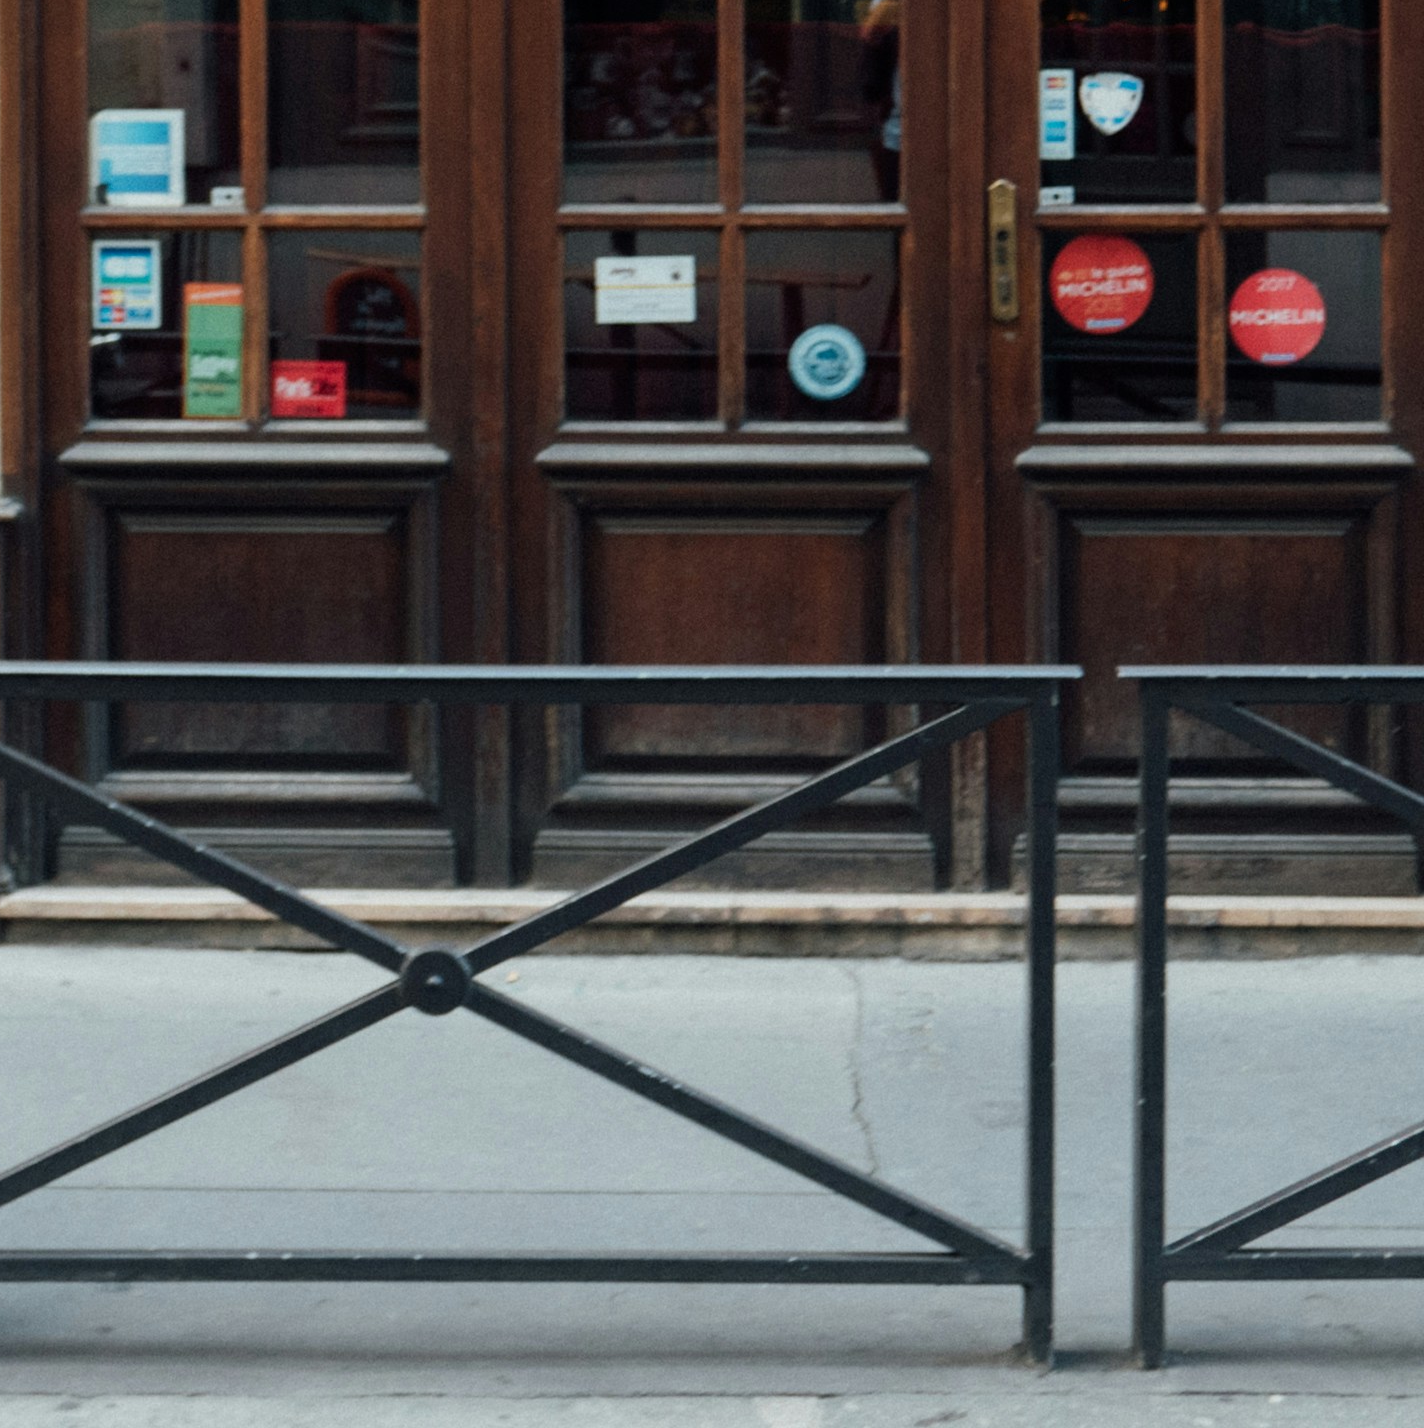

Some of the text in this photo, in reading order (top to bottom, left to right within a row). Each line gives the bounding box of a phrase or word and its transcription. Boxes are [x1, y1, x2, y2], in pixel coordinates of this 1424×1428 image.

[1058, 279, 1147, 298] MICHELIN
[1257, 276, 1296, 292] 2017
[1231, 309, 1324, 325] MICHELIN
